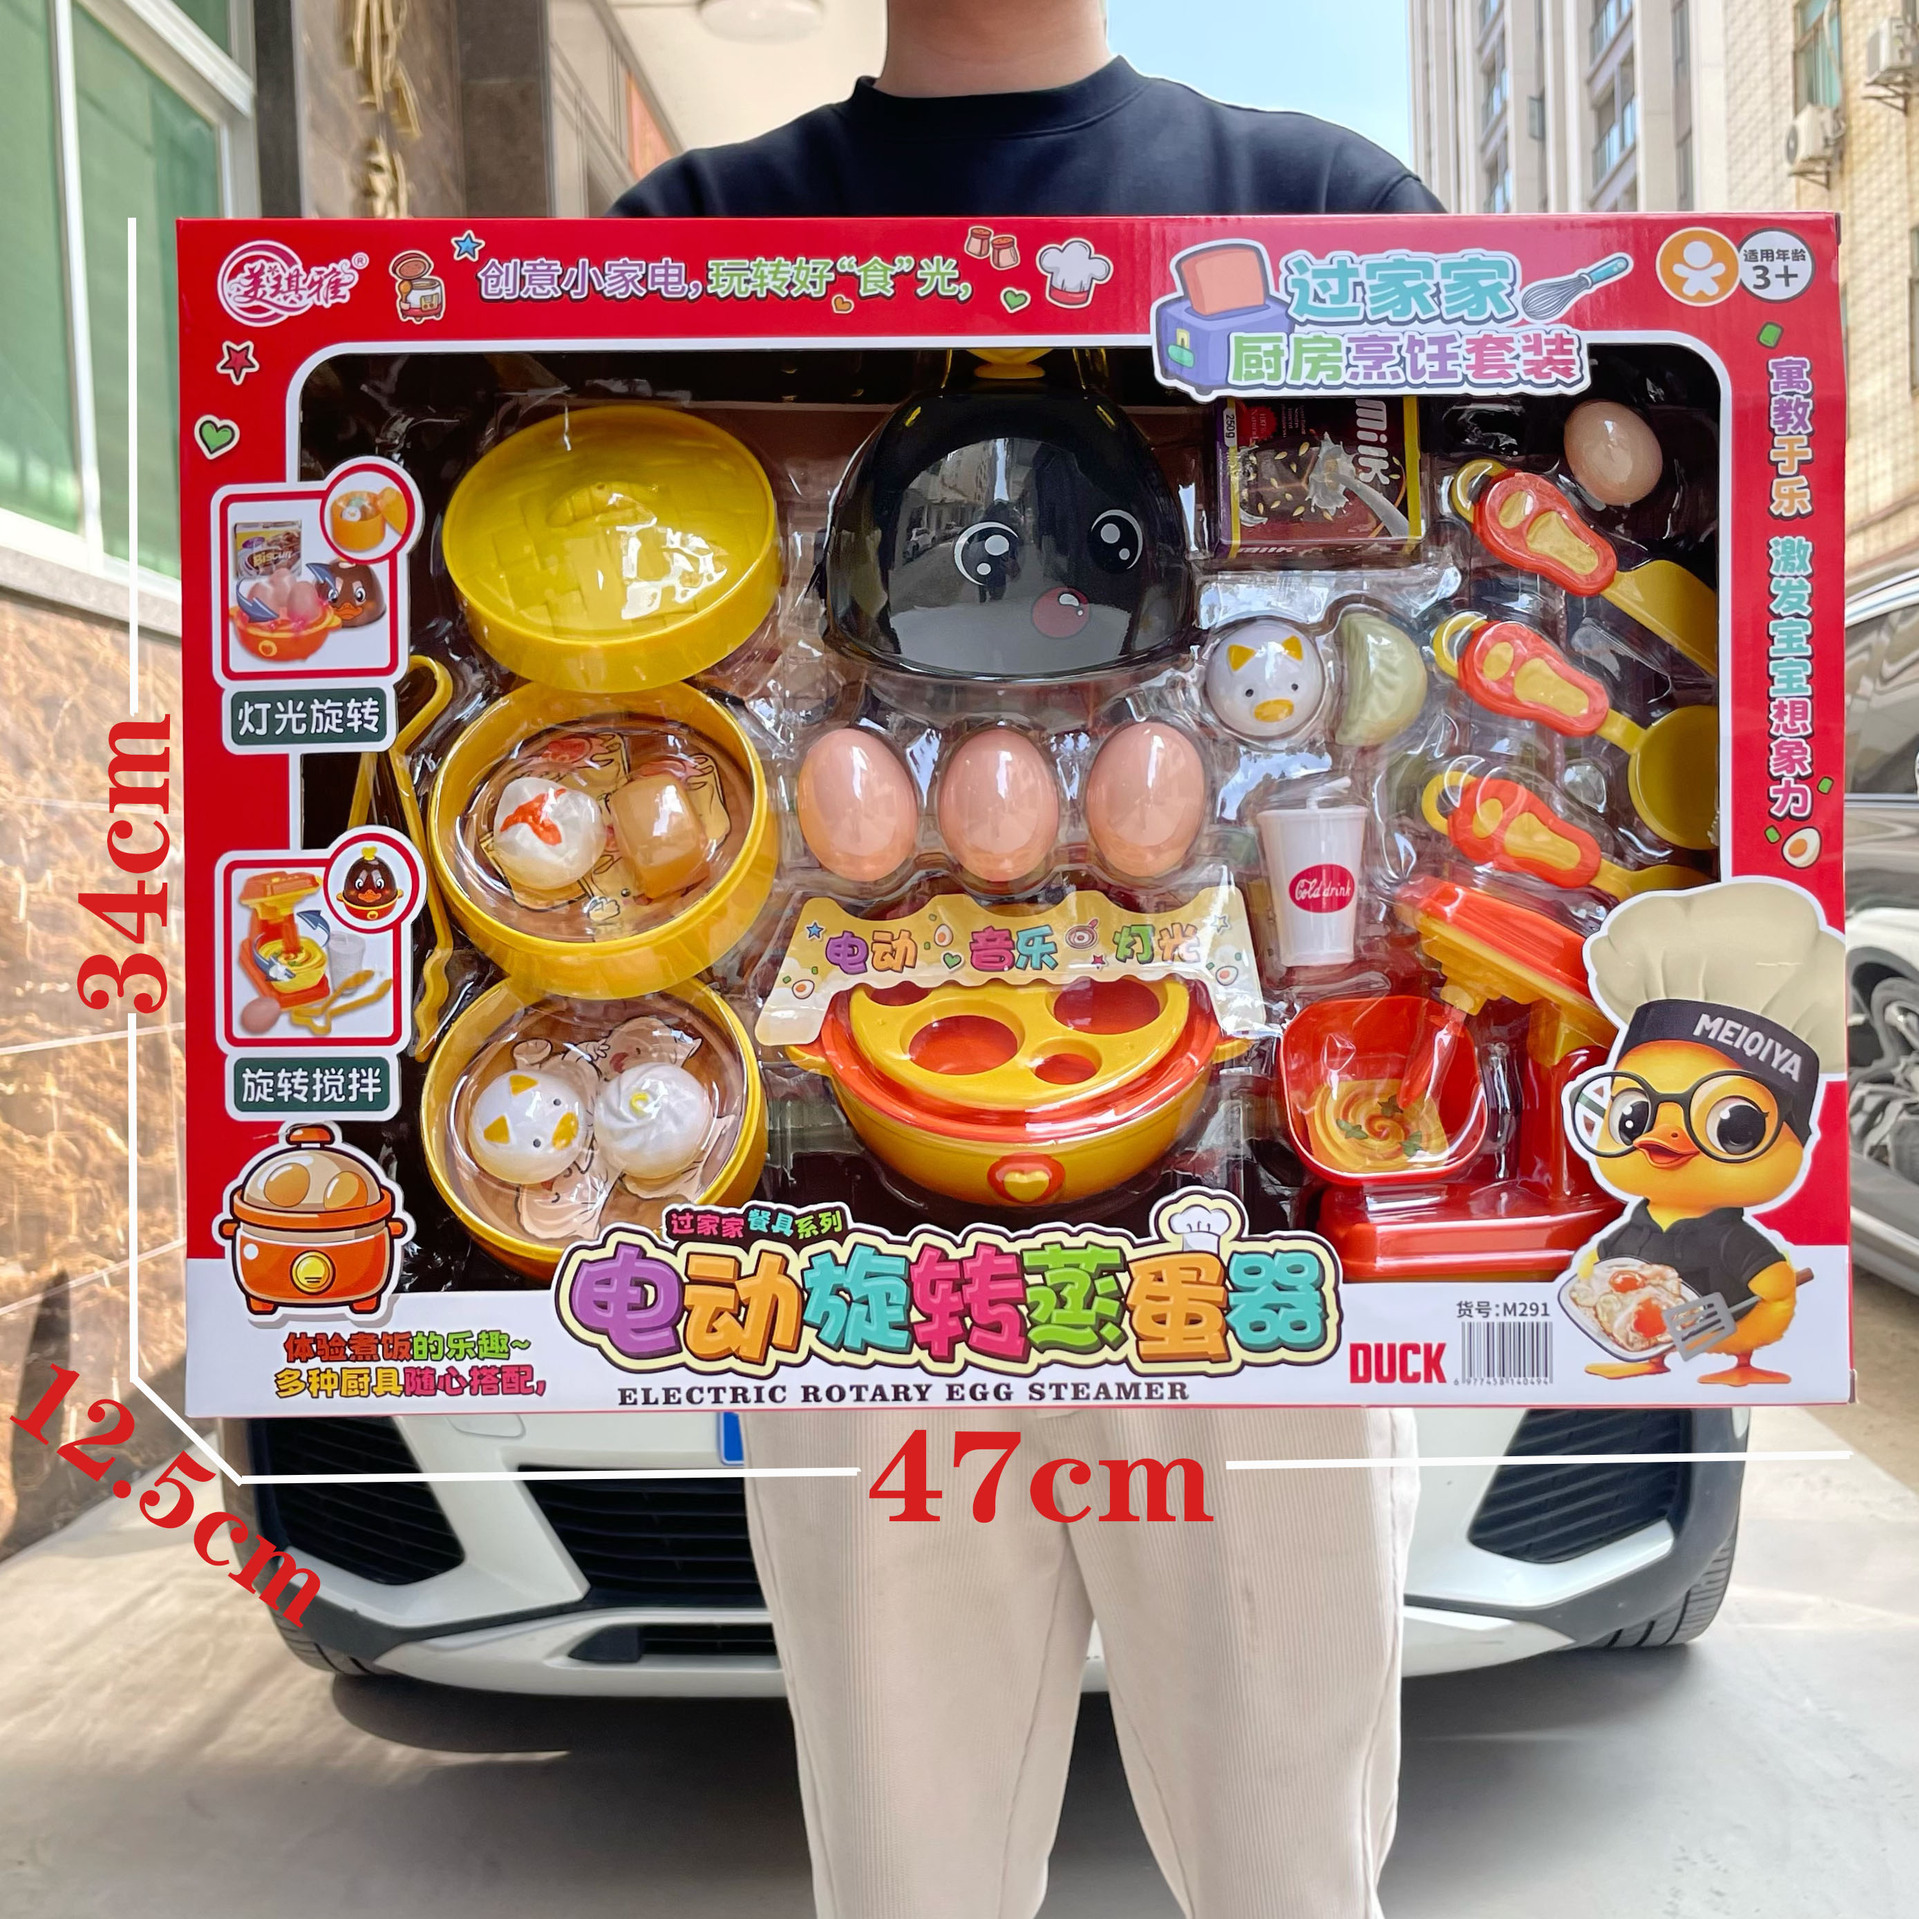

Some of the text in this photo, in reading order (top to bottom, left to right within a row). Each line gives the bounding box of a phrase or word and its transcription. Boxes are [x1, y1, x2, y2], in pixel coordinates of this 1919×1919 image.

[1743, 248, 1806, 262] 适用年龄
[1290, 256, 1514, 319] 过家家
[1752, 265, 1798, 290] 3+
[1232, 332, 1578, 382] 厨房烹饪套装
[1225, 414, 1236, 439] 250g
[1768, 356, 1813, 818] 寓教于乐 激发宝宝想象力
[238, 698, 380, 736] 灯光旋转
[1322, 879, 1352, 898] drink
[825, 922, 1200, 974] 电动 音乐 灯光
[1693, 1013, 1802, 1083] MEIQIYA
[241, 1067, 383, 1103] 旋转搅拌
[671, 1209, 844, 1240] 过家家餐具系列
[572, 1242, 1323, 1362] 电动旋转蒸蛋器
[1349, 1342, 1447, 1384] DUCK
[618, 1382, 1190, 1406] ELECTRIC ROTARY EGG STEAMER
